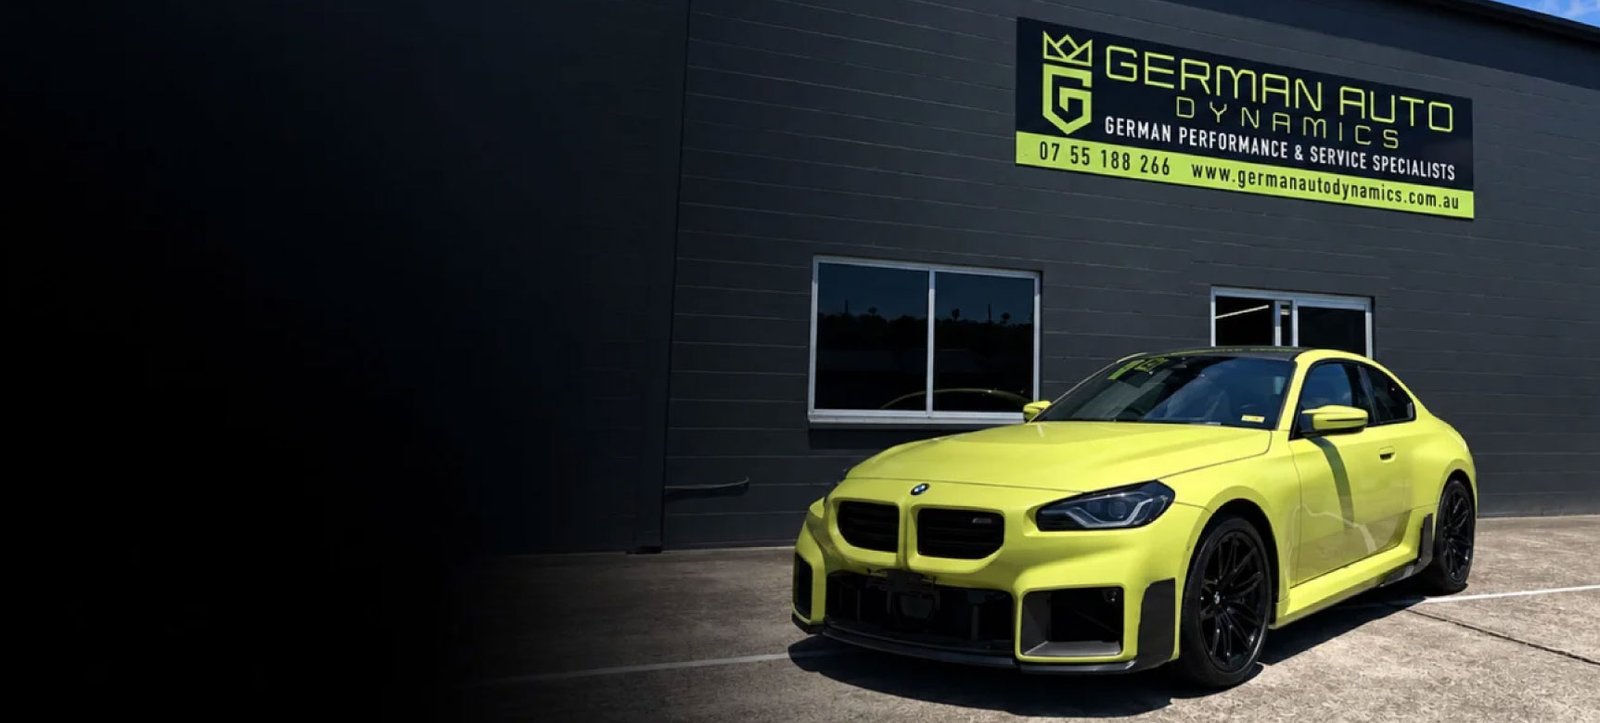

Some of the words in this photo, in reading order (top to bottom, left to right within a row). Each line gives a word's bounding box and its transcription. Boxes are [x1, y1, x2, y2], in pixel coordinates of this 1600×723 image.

[1106, 45, 1322, 112] GERMAN
[1340, 86, 1453, 132] AUTO
[1105, 116, 1171, 142] GERMAN
[1179, 126, 1288, 159] PERFORMANCE
[1294, 144, 1303, 161] &
[1310, 145, 1367, 170] SERVICE
[1372, 155, 1455, 181] SPECIALISTS
[1176, 96, 1399, 149] DYNAMICS
[1040, 141, 1060, 161] 07
[1070, 145, 1090, 166] 55
[1101, 149, 1130, 171] 188
[1140, 154, 1170, 175] 266
[1191, 164, 1459, 209] www.germanautodynamics.com.au
